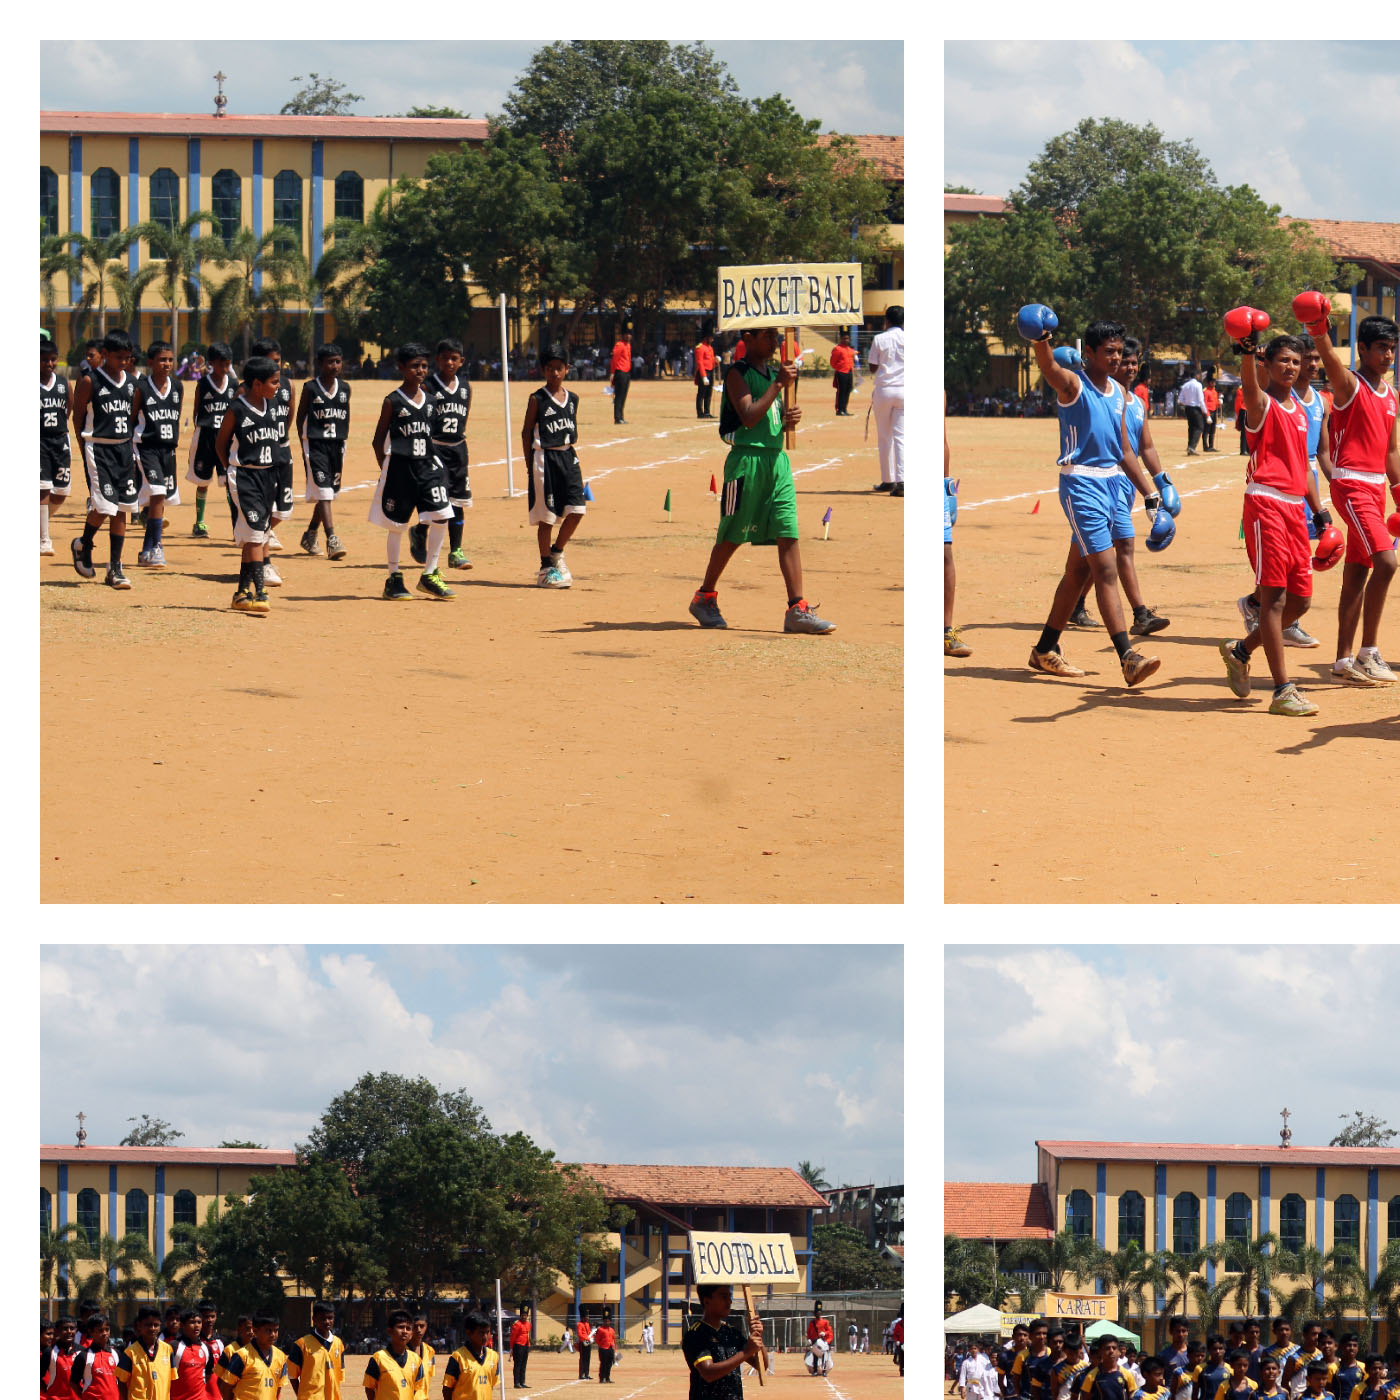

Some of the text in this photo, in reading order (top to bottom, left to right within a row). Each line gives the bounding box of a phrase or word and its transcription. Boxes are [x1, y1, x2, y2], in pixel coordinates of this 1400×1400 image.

[722, 275, 861, 318] BASKET BALL
[44, 412, 58, 427] 25
[115, 416, 128, 434] 35
[443, 418, 457, 433] 23
[160, 424, 173, 439] 99
[323, 423, 336, 437] 29
[413, 438, 426, 456] 98
[56, 467, 71, 483] 25
[431, 486, 447, 503] 98
[697, 1242, 794, 1275] FOOTBALL
[1056, 1298, 1107, 1316] KARATE
[264, 1377, 274, 1388] 10
